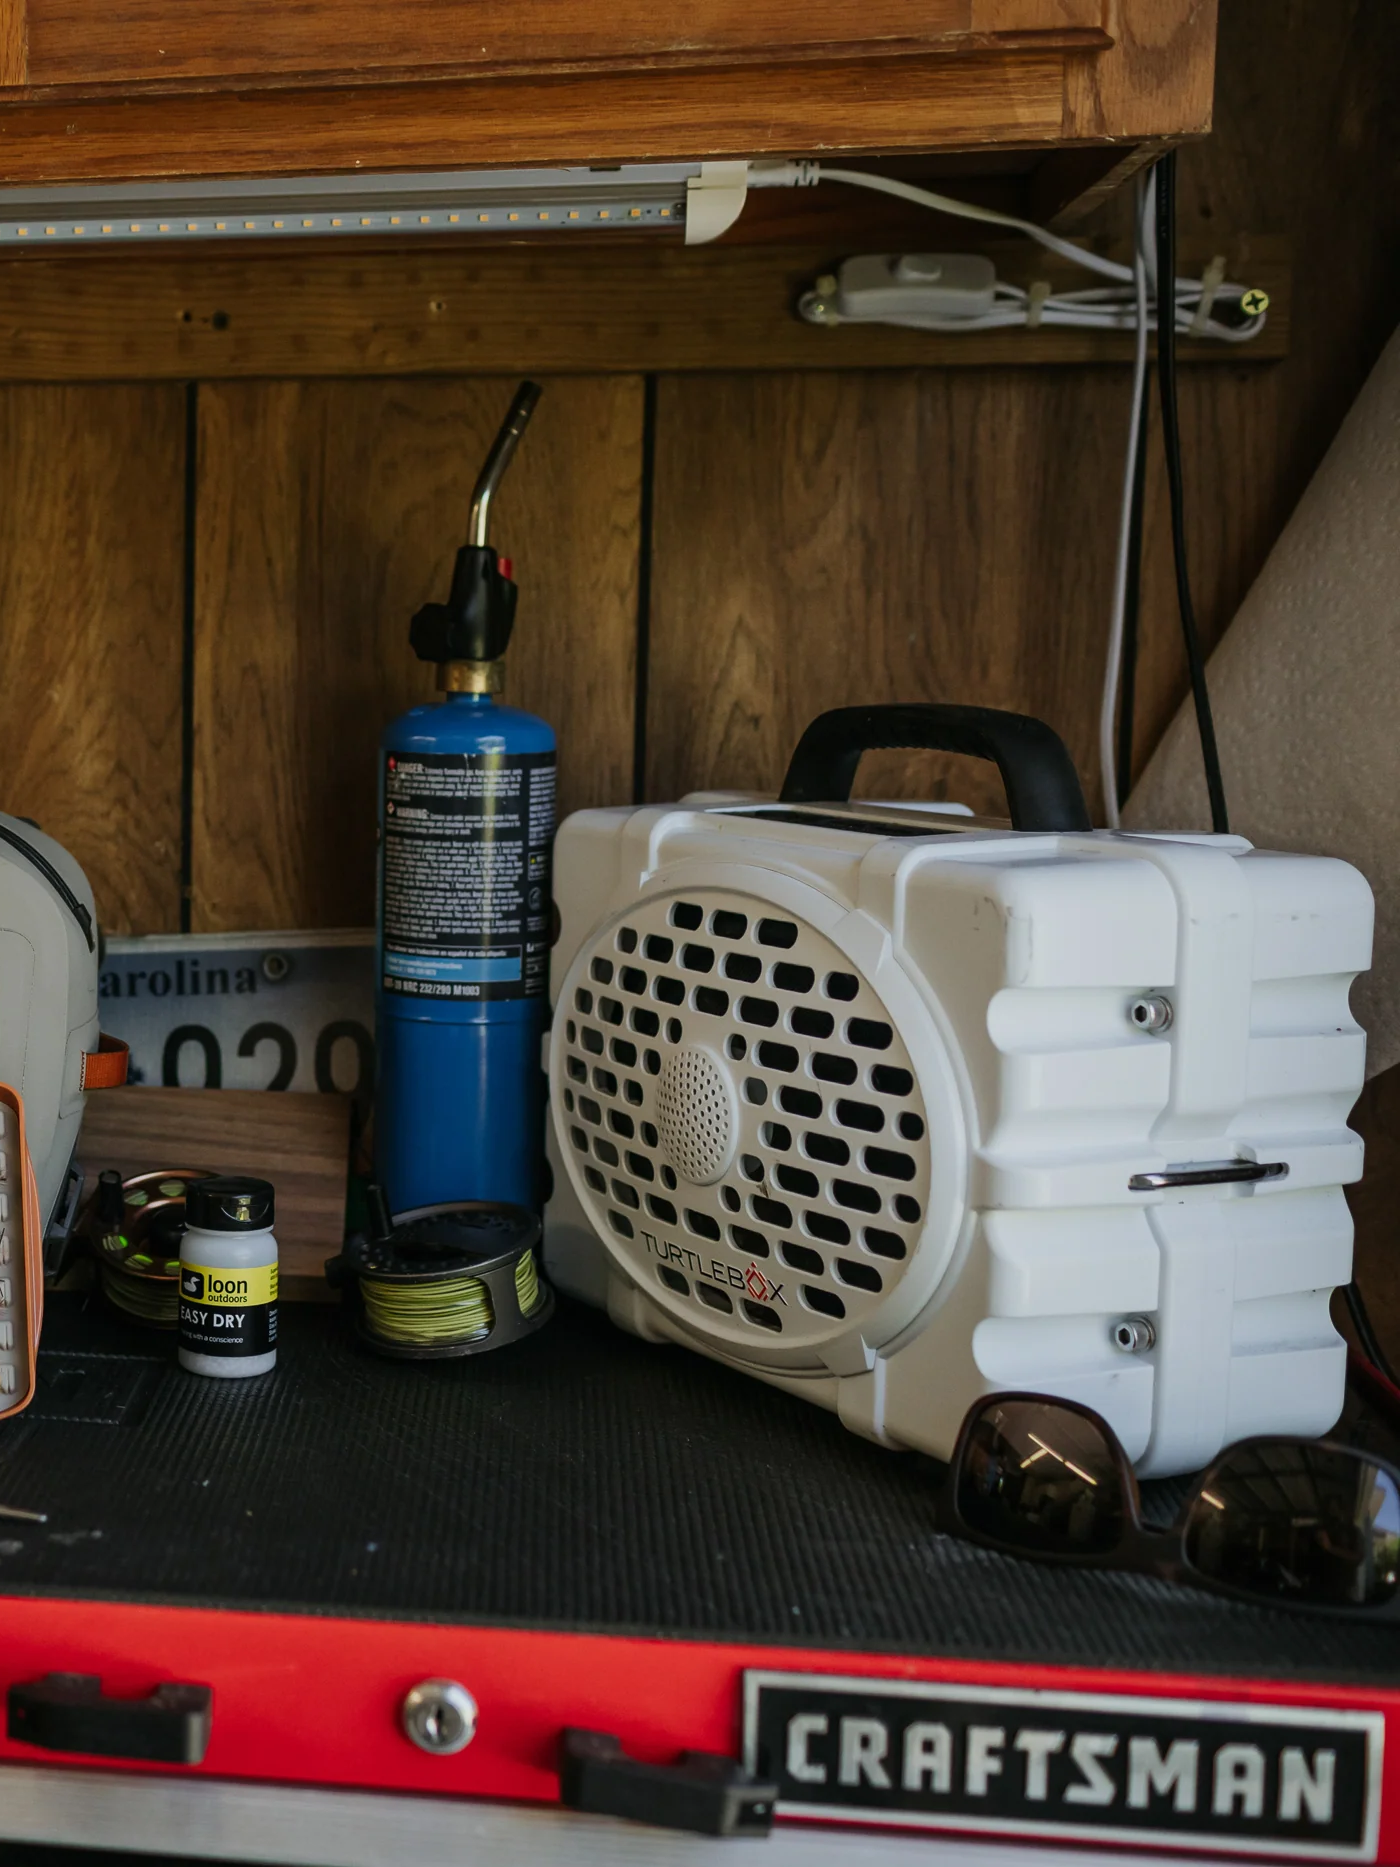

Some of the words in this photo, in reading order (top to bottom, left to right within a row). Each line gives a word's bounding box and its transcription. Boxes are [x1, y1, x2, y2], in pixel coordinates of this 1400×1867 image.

[640, 1230, 789, 1306] TURTLEBOX
[208, 1274, 248, 1294] loon
[208, 1294, 248, 1303] outdoors
[181, 1306, 208, 1325] EASY
[213, 1313, 245, 1328] DRY
[209, 1335, 244, 1344] conscience
[786, 1712, 1336, 1823] CRAFTSMAN
